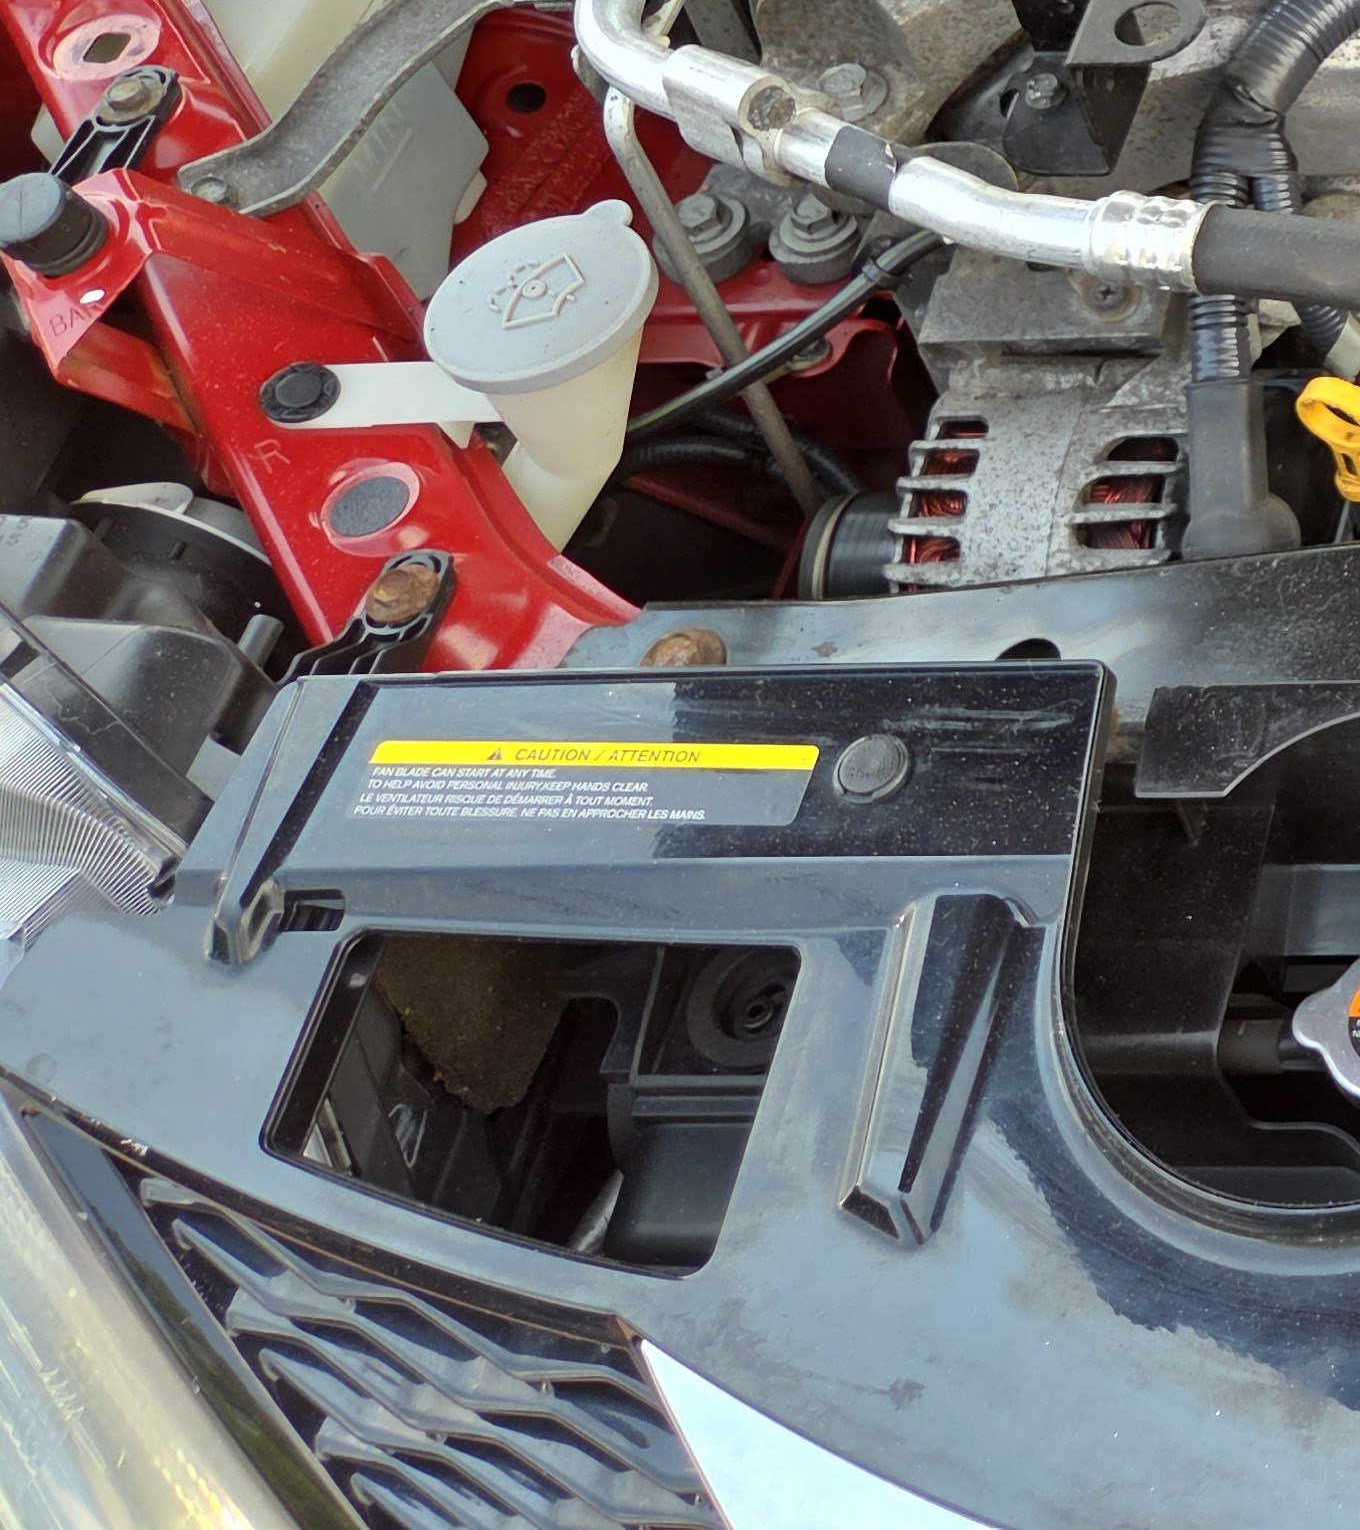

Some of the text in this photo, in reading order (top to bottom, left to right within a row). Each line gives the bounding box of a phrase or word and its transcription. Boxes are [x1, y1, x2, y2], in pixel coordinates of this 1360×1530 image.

[514, 748, 590, 761] CAUTION
[608, 749, 700, 762] ATTENTION
[371, 767, 395, 776] FAN
[394, 767, 430, 777] BLADE
[430, 767, 456, 777] CAN
[456, 767, 490, 777] START
[490, 768, 505, 777] AT
[506, 768, 530, 777] ANY
[366, 779, 383, 789] TO
[382, 779, 412, 789] HELP
[412, 779, 446, 789] AVOID
[446, 779, 504, 790] PERSONAL
[571, 781, 611, 791] HANDS
[359, 792, 374, 802] LE
[374, 792, 444, 803] VENTILATEUR
[444, 793, 486, 804] RISQUE
[486, 794, 502, 804] DE
[503, 792, 564, 805] DÉMARRER
[574, 795, 604, 805] TOUT
[604, 795, 655, 806] MOMENT.
[353, 805, 386, 815] POUR
[386, 803, 424, 815] ÉVITER
[424, 806, 460, 816] TOUTE
[520, 807, 537, 816] NE
[537, 807, 560, 817] PAS
[561, 808, 577, 817] EN
[577, 808, 647, 819] APPROCHER
[647, 809, 669, 819] LES
